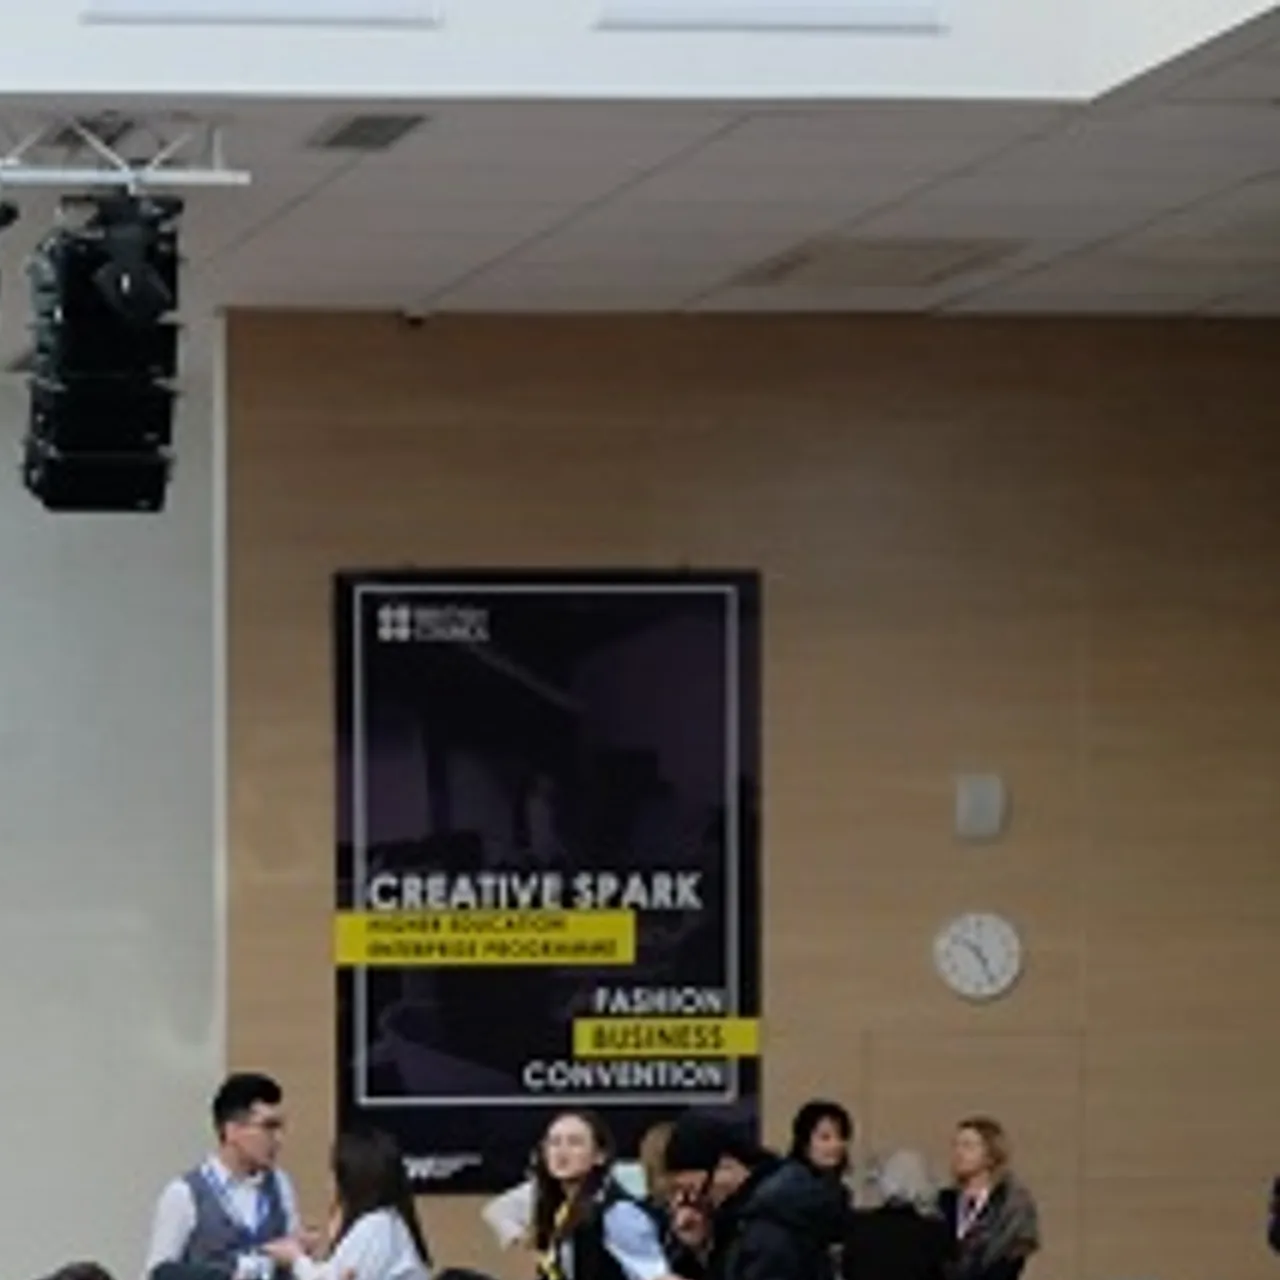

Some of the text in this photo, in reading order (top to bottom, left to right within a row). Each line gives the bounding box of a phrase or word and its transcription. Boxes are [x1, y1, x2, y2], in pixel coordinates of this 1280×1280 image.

[370, 872, 702, 909] CREATIVE SPARK
[450, 917, 568, 934] EDUCATION
[595, 988, 722, 1013] FASHION
[591, 1025, 724, 1049] BUSINESS
[523, 1061, 722, 1088] CONVENTION
